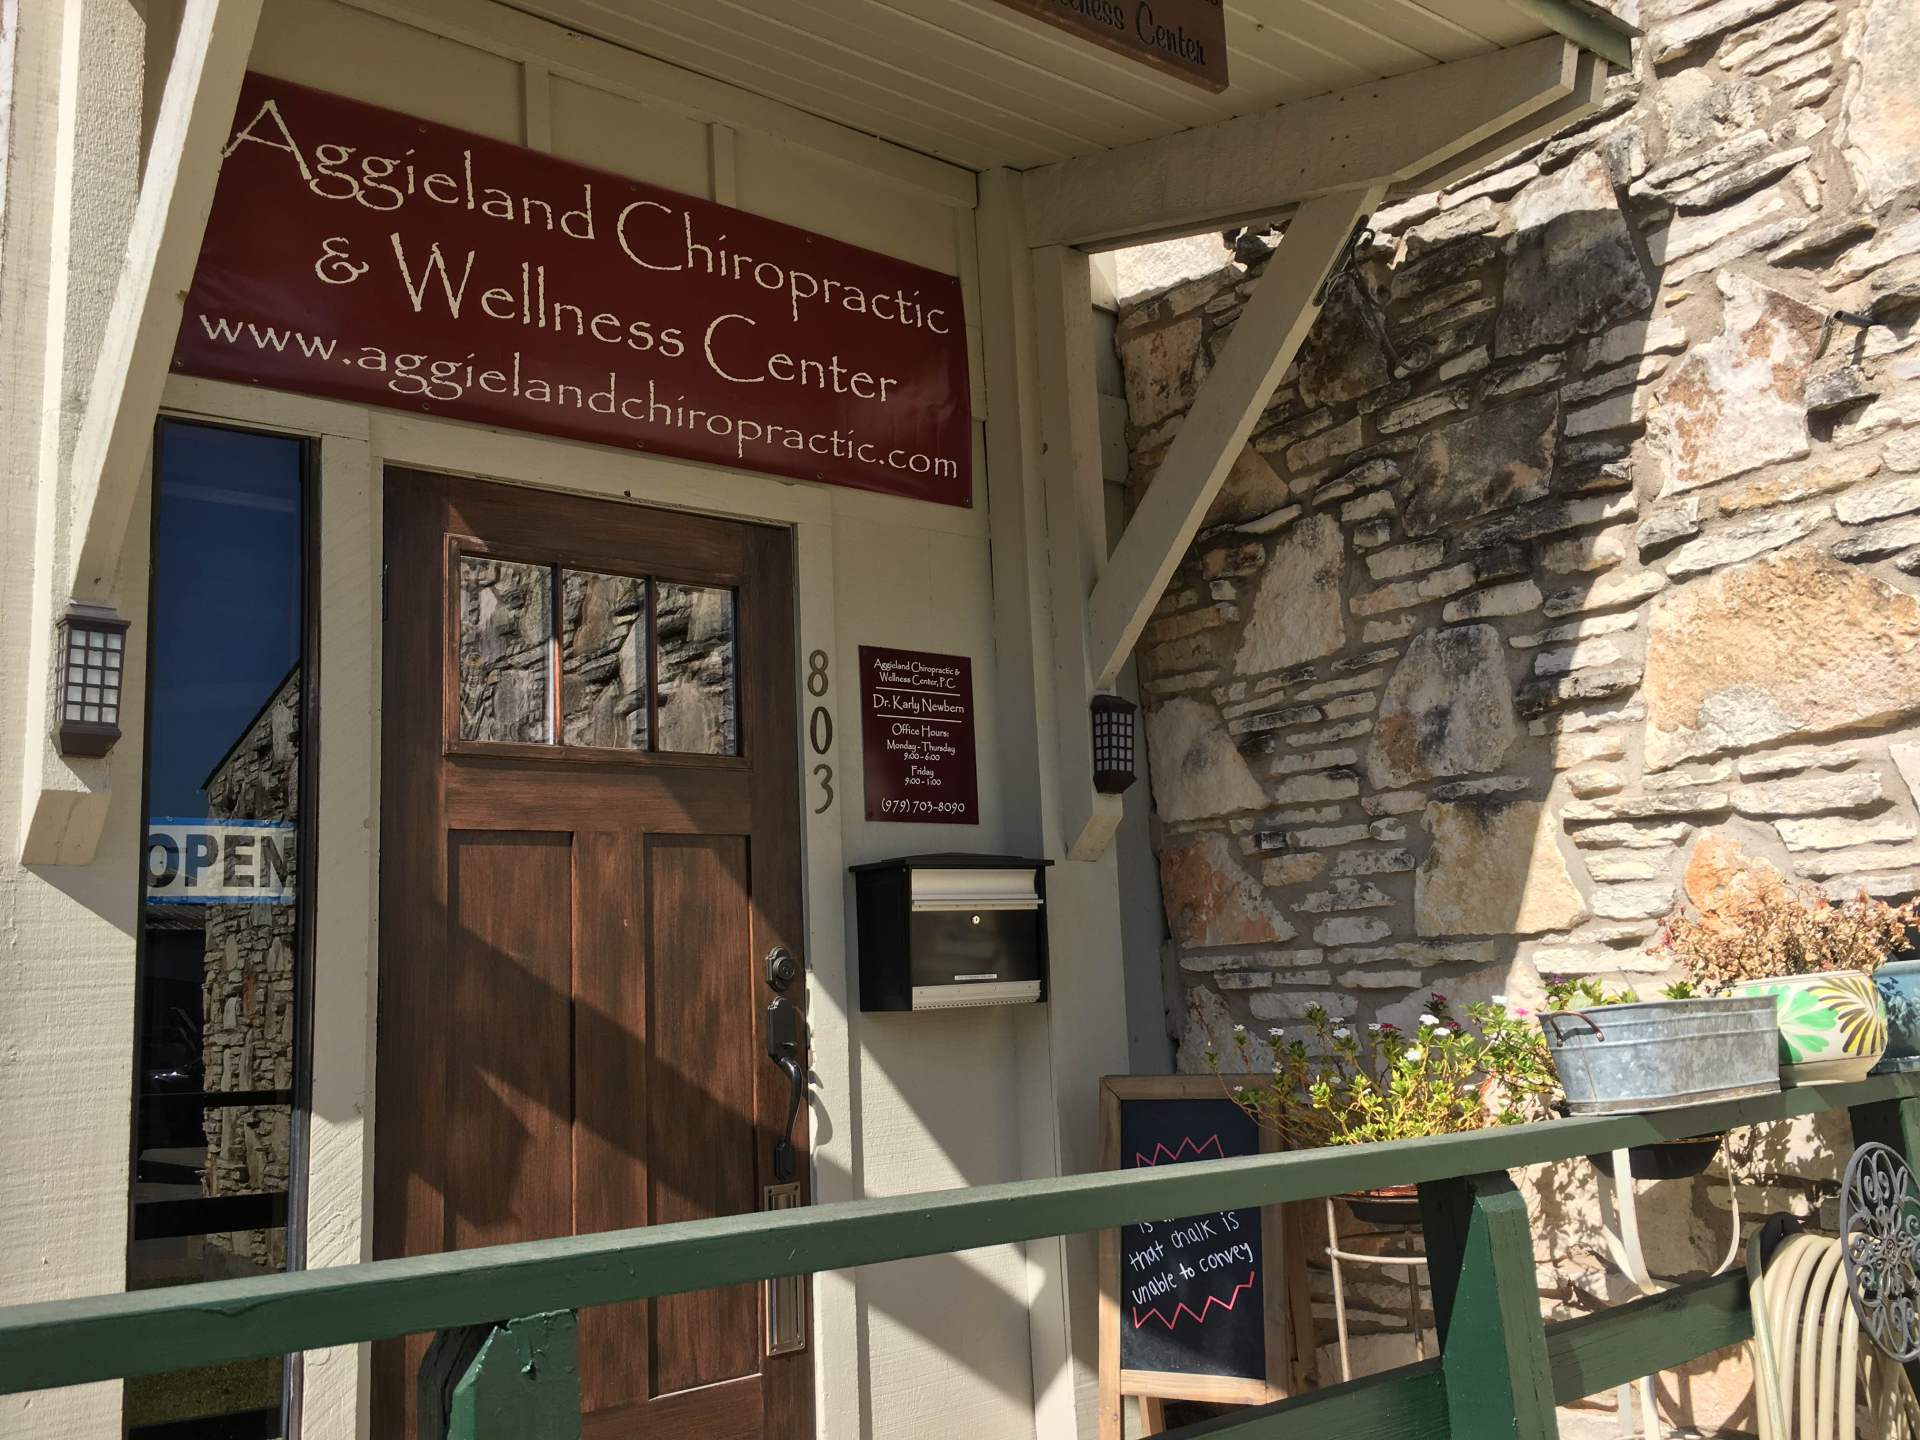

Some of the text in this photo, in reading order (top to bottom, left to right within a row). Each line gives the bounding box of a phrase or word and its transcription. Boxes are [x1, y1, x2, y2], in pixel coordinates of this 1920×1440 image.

[1136, 0, 1205, 65] Center
[222, 99, 949, 334] Aggieland Chiropractic
[314, 232, 897, 402] & Wellness Center
[199, 314, 958, 479] www.aggielandchiropractic.com
[873, 658, 961, 677] Aggieland Chiropractic &
[879, 671, 911, 683] Wellness
[911, 674, 939, 688] Center,
[872, 693, 891, 708] Dr.
[892, 694, 920, 714] Karly
[807, 649, 834, 815] 803
[891, 722, 950, 738] Office Hours:
[886, 739, 917, 753] Monday
[921, 741, 956, 756] Thursday
[903, 752, 920, 761] 9:00
[924, 752, 941, 761] 6:00
[904, 777, 921, 786] 9:00
[926, 778, 942, 786] 1:00
[911, 765, 935, 779] Friday
[881, 797, 966, 815] (979) 703-8090
[147, 833, 296, 888] OPEN
[1129, 1240, 1164, 1272] that
[1221, 1210, 1240, 1231] is
[1132, 1241, 1253, 1305] unable to convey
